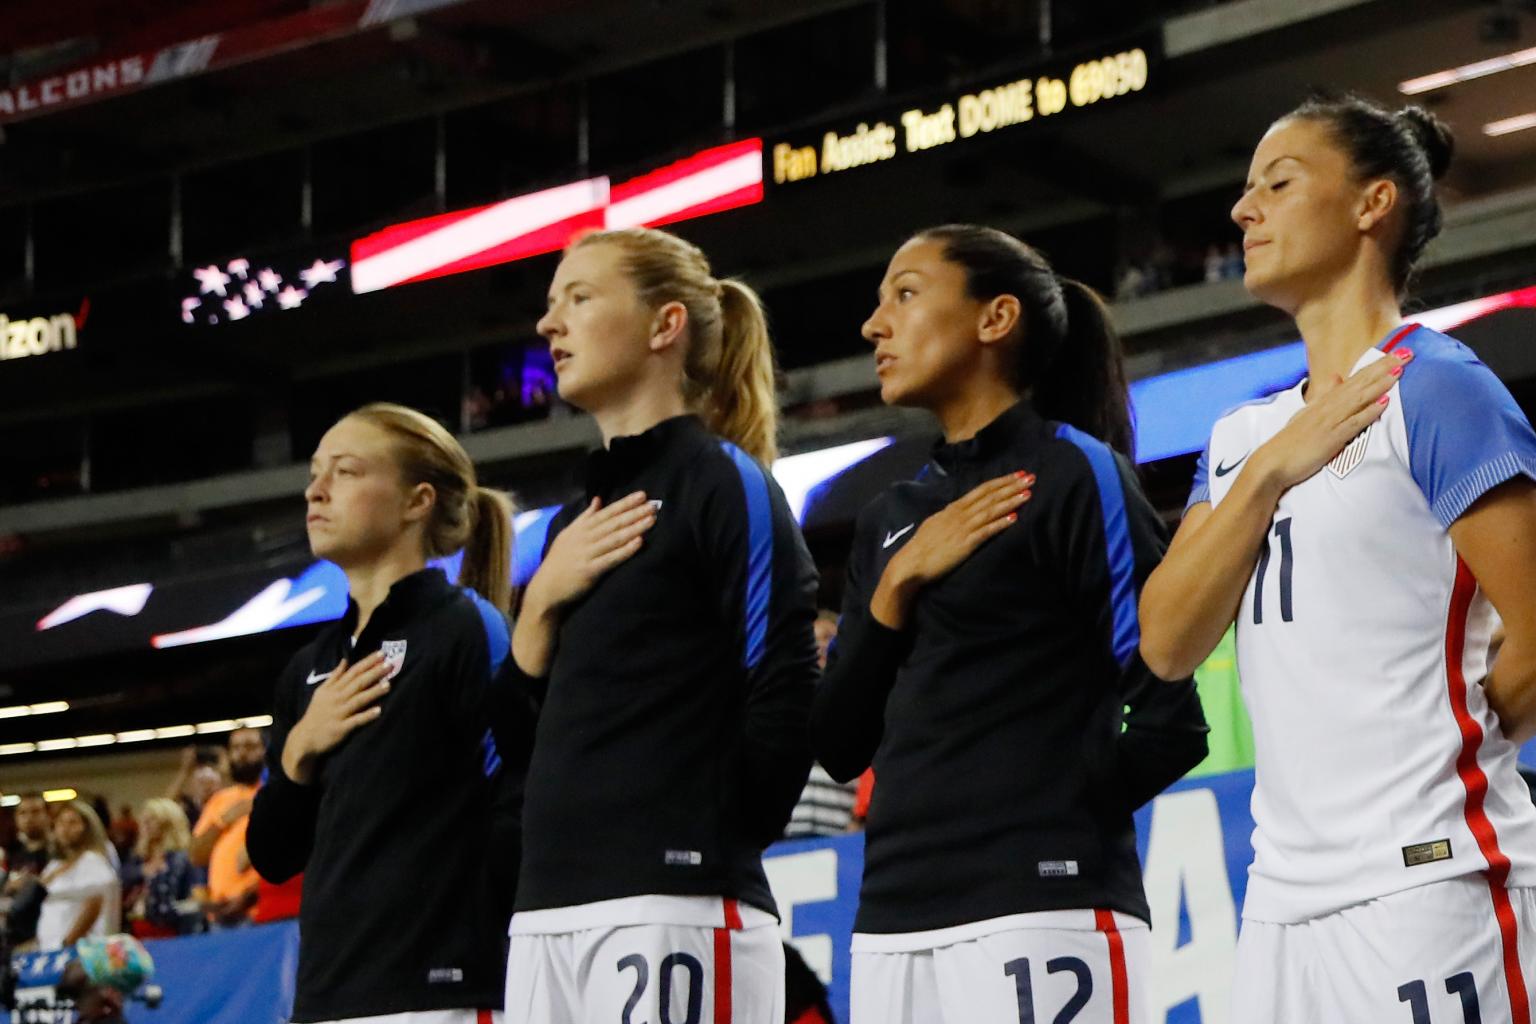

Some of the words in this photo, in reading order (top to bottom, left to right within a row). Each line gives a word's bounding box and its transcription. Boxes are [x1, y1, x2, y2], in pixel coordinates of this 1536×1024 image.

[773, 142, 818, 184] Fan
[901, 103, 956, 152] Text
[958, 78, 1034, 138] DOME
[1036, 76, 1067, 116] to
